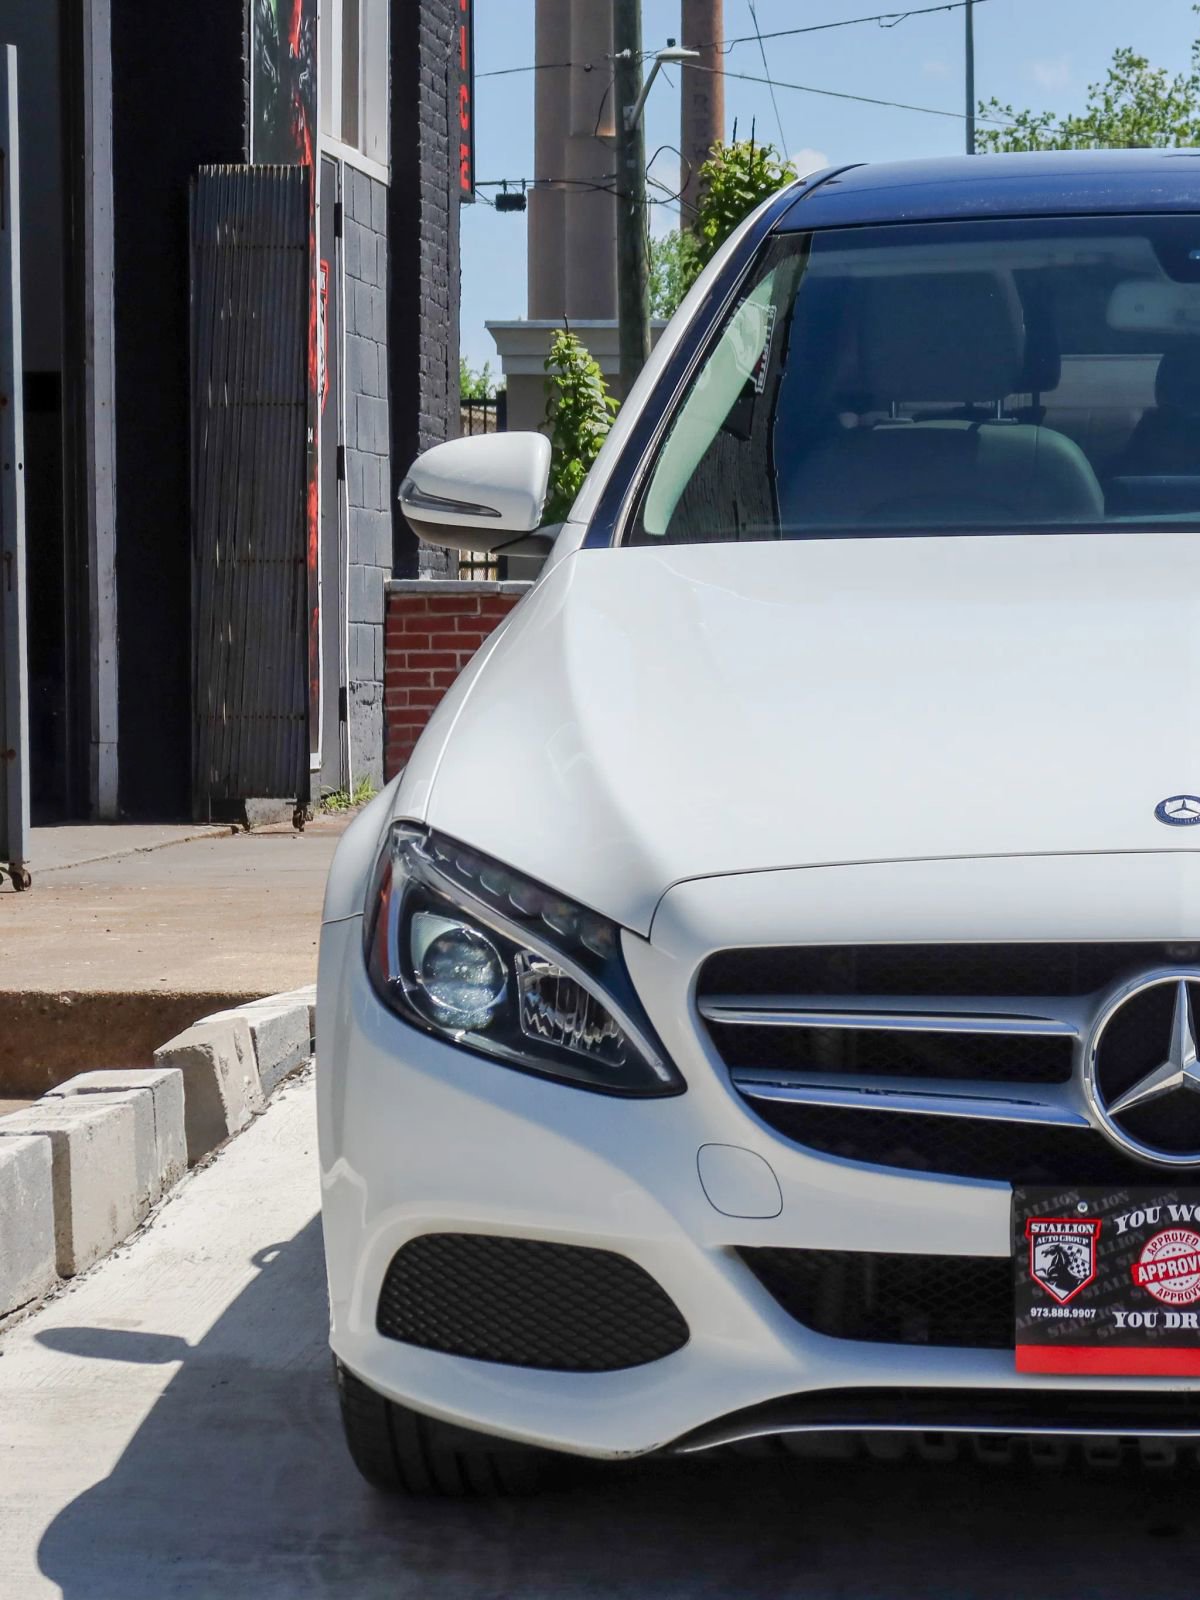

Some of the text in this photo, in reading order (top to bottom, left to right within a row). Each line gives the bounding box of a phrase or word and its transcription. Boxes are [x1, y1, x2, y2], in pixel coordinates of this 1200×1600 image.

[459, 0, 470, 191] ICE
[1030, 1223, 1095, 1234] STALLION
[1114, 1206, 1161, 1235] YOU
[1036, 1235, 1089, 1246] AUTO GROUP
[1147, 1232, 1199, 1255] APPROVED
[1030, 1307, 1097, 1318] 973.888.9907
[1112, 1311, 1159, 1328] YOU
